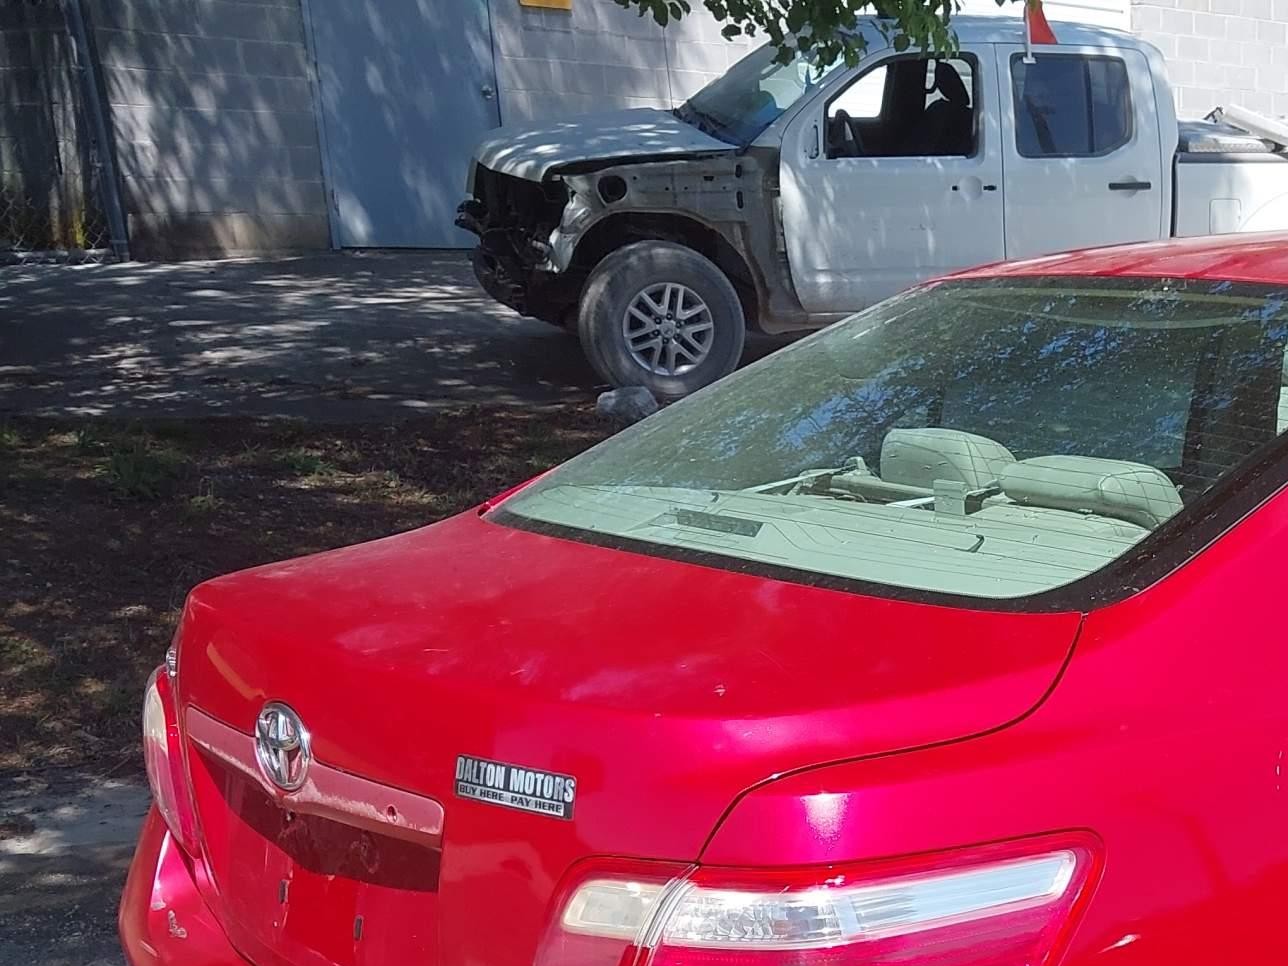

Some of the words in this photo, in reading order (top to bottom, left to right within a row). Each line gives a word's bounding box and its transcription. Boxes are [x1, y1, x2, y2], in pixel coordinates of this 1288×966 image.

[456, 756, 506, 789] DALTON
[509, 768, 575, 802] MOTORS
[459, 783, 477, 795] BUY
[480, 789, 505, 802] HERE
[510, 796, 531, 808] PAY
[534, 800, 563, 814] HERE
